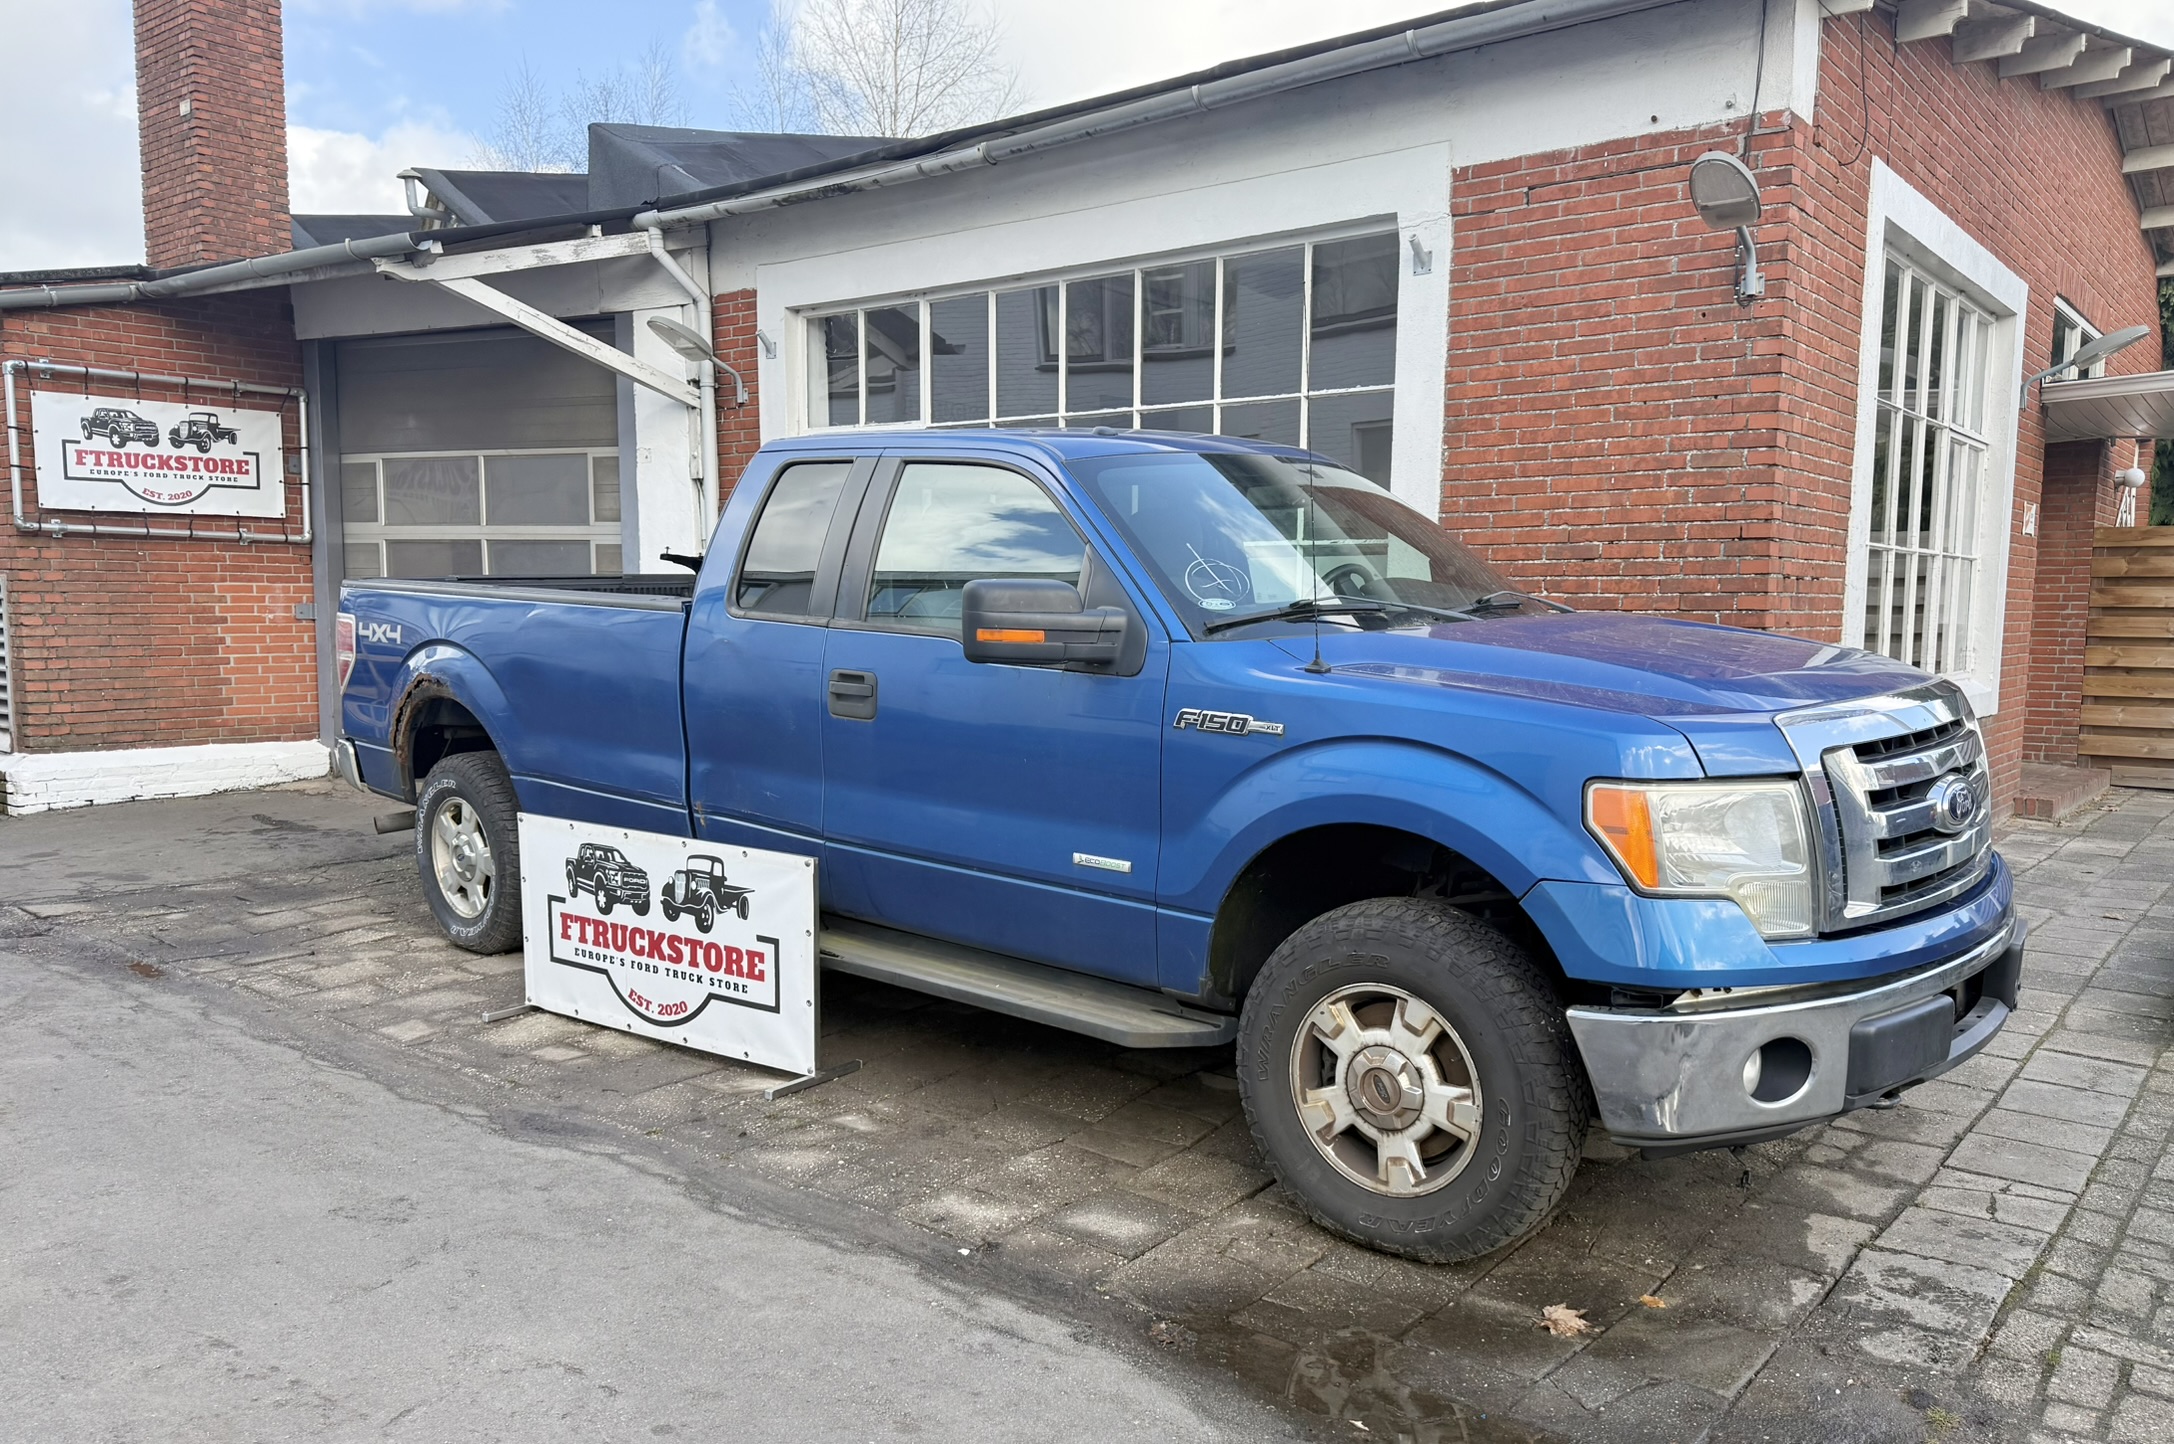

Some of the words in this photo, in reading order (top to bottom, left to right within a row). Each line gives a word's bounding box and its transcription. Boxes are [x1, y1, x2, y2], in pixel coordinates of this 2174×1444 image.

[74, 449, 250, 476] FTRUCKSTORE
[89, 469, 139, 477] EUROPE'S
[143, 471, 169, 479] FORD
[142, 487, 166, 501] EST.
[167, 489, 193, 501] 2020
[358, 621, 402, 645] 4X4
[1174, 708, 1253, 736] F-150
[1264, 724, 1281, 732] XLT
[623, 876, 647, 884] FORD
[560, 912, 765, 982] FTRUCKSTORE
[574, 948, 626, 968] EUROPE'S
[631, 961, 659, 975] FORD
[665, 967, 704, 985] TRUCK
[709, 977, 749, 994] STORE
[627, 987, 655, 1014] EST.
[657, 1000, 689, 1016] 2020
[1257, 952, 1391, 1081] WRANGLER
[1358, 1097, 1512, 1234] GOODYEAR
